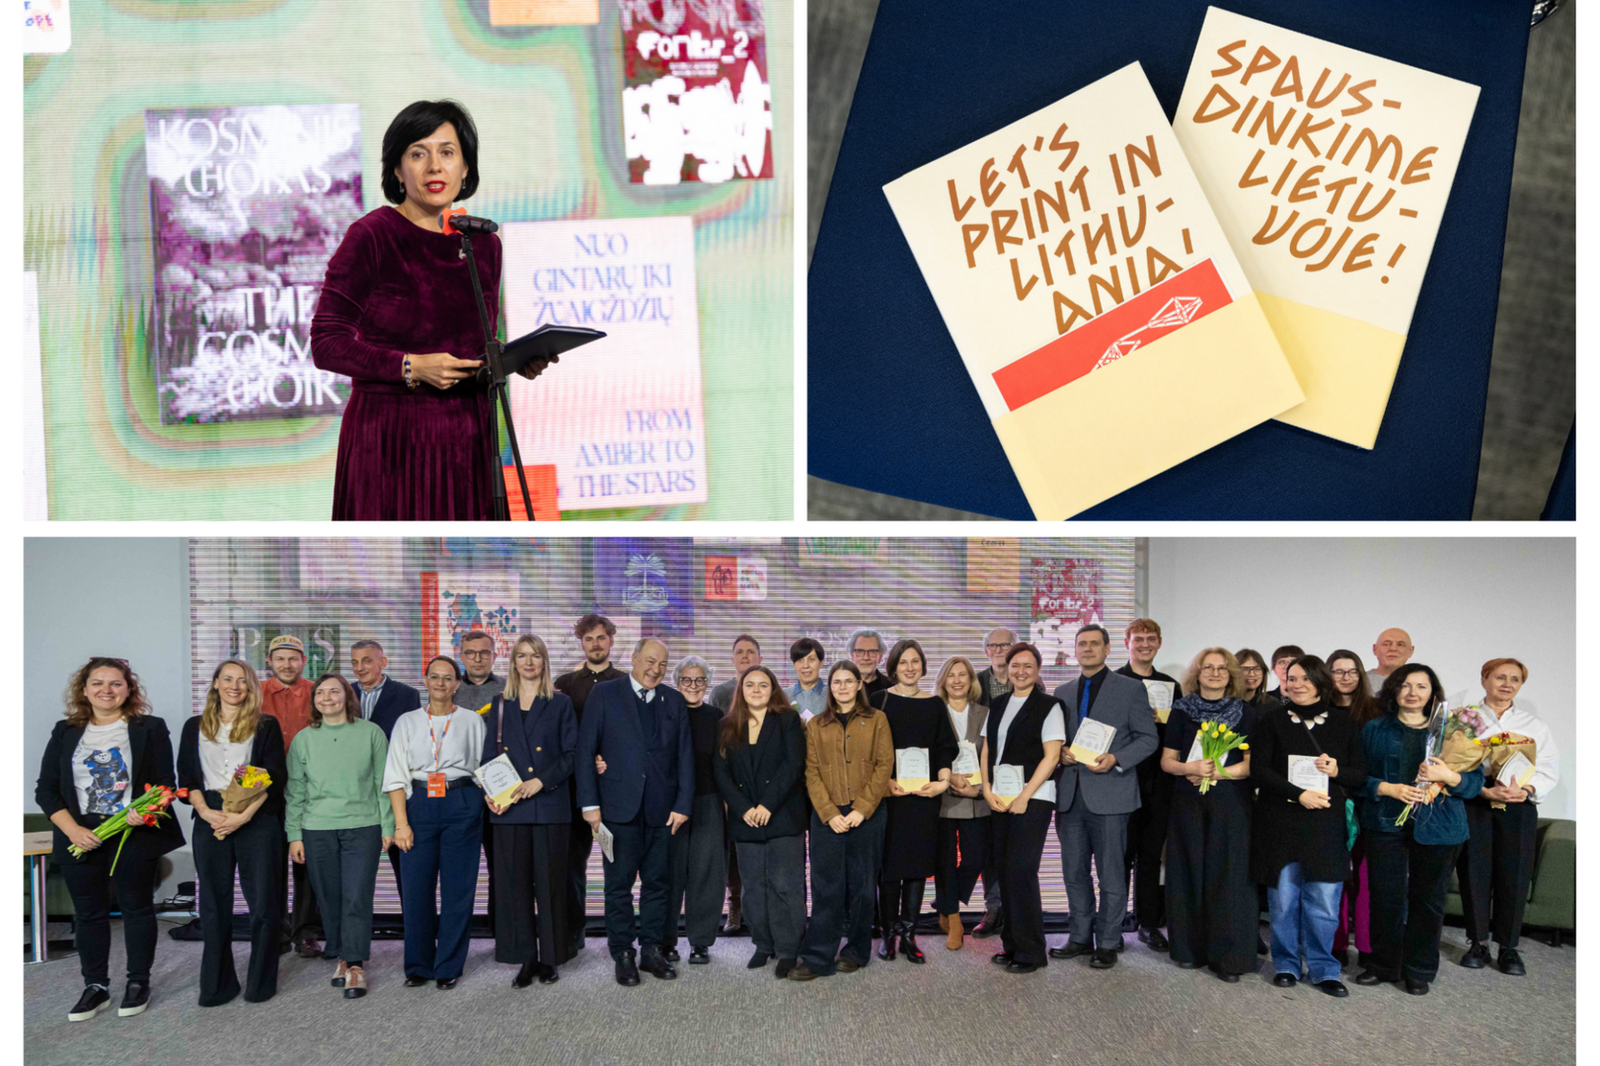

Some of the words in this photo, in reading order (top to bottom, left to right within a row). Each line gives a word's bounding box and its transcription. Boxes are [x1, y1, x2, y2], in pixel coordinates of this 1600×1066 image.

[1211, 39, 1402, 117] SPAUS-
[1193, 83, 1439, 185] DINKIME
[947, 122, 1080, 222] LET'S
[961, 165, 1092, 269] PRINT
[1109, 134, 1162, 196] IN
[1238, 148, 1419, 223] LIETU-
[574, 232, 629, 260] NUO
[642, 264, 672, 289] IKI
[1009, 194, 1175, 301] LITHU-
[1252, 204, 1407, 284] VOJE!
[226, 371, 343, 408] CHOIR
[625, 408, 693, 433] FROM
[573, 475, 621, 498] THE
[624, 469, 697, 497] STARS
[575, 440, 656, 468] AMBER
[659, 440, 695, 463] TO
